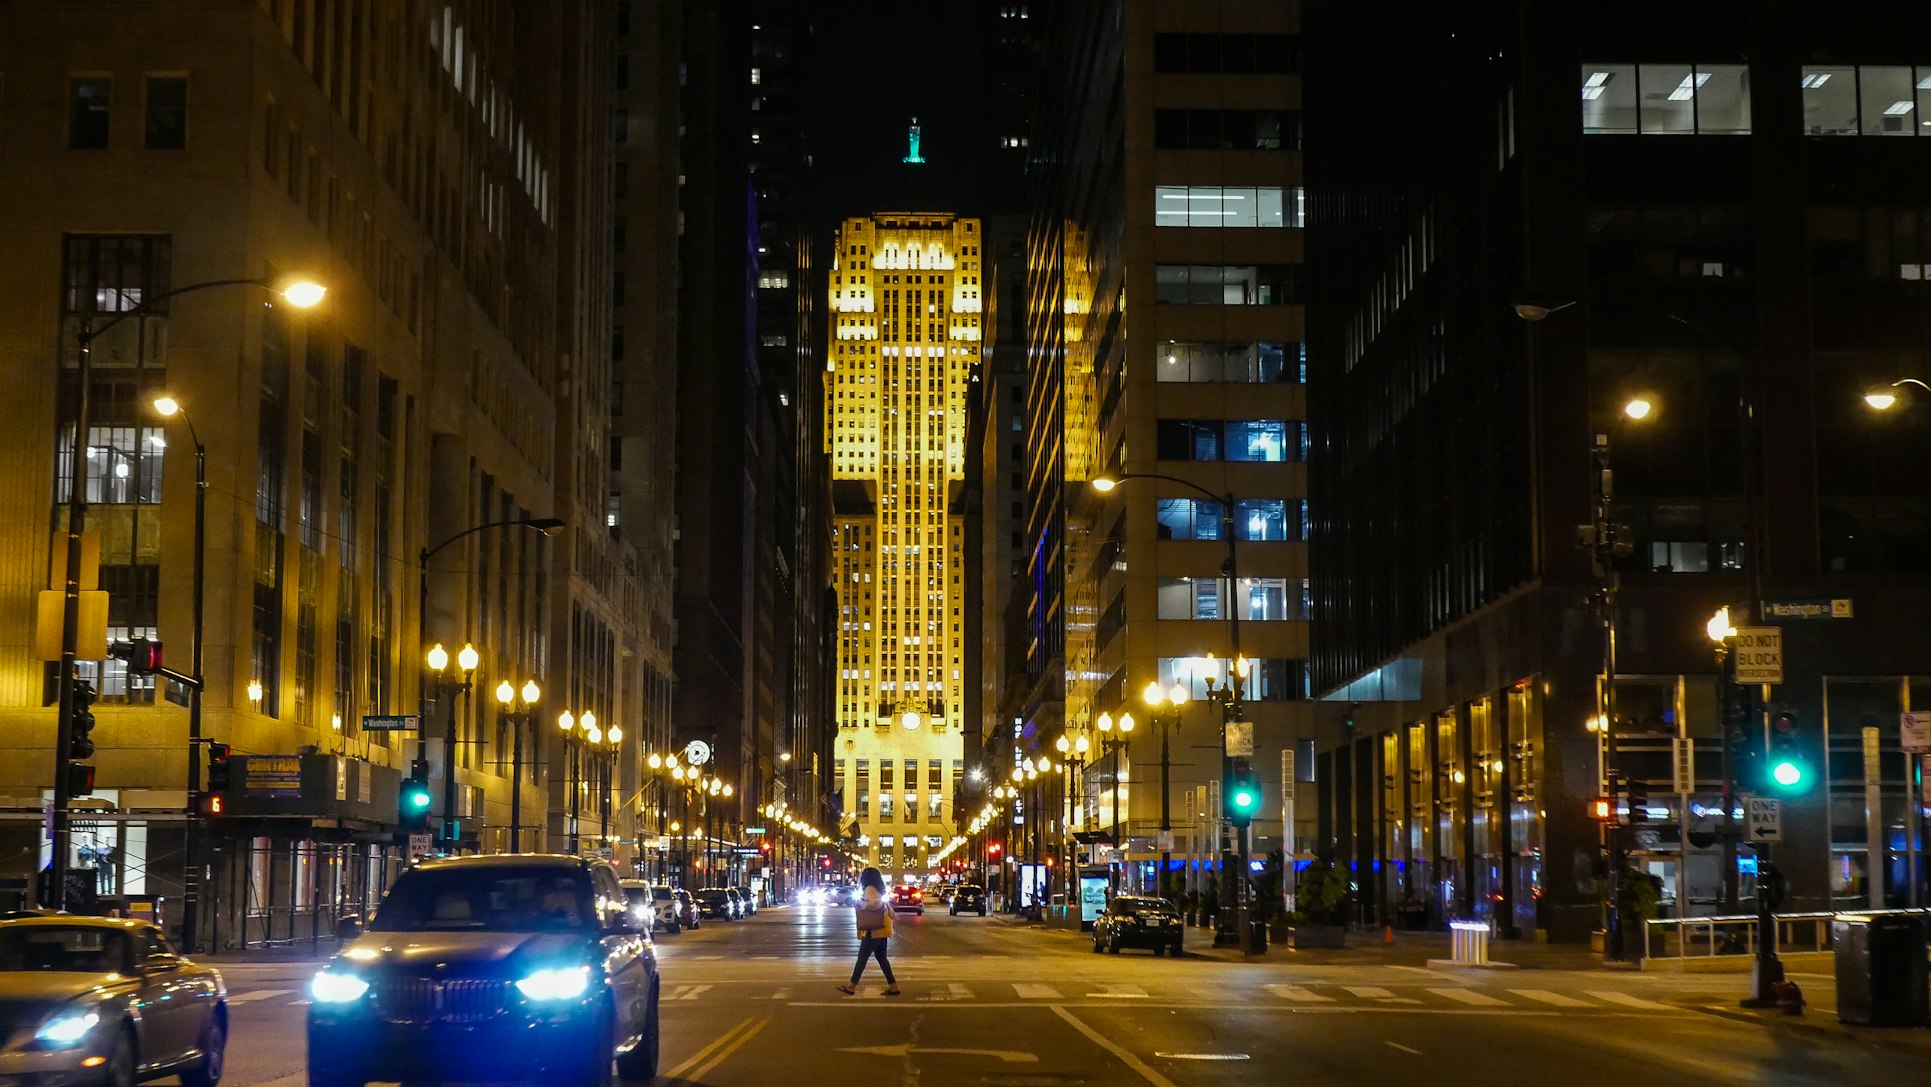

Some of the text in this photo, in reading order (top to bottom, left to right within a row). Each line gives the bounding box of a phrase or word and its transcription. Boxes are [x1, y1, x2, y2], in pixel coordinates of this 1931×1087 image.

[1773, 603, 1821, 618] Washington
[1739, 634, 1779, 647] DO NOT
[1739, 652, 1780, 665] BLOCK
[368, 719, 399, 729] Washington
[212, 797, 220, 812] 6
[1752, 800, 1777, 811] ONE
[1752, 813, 1777, 824] WAY
[411, 836, 428, 844] ONE
